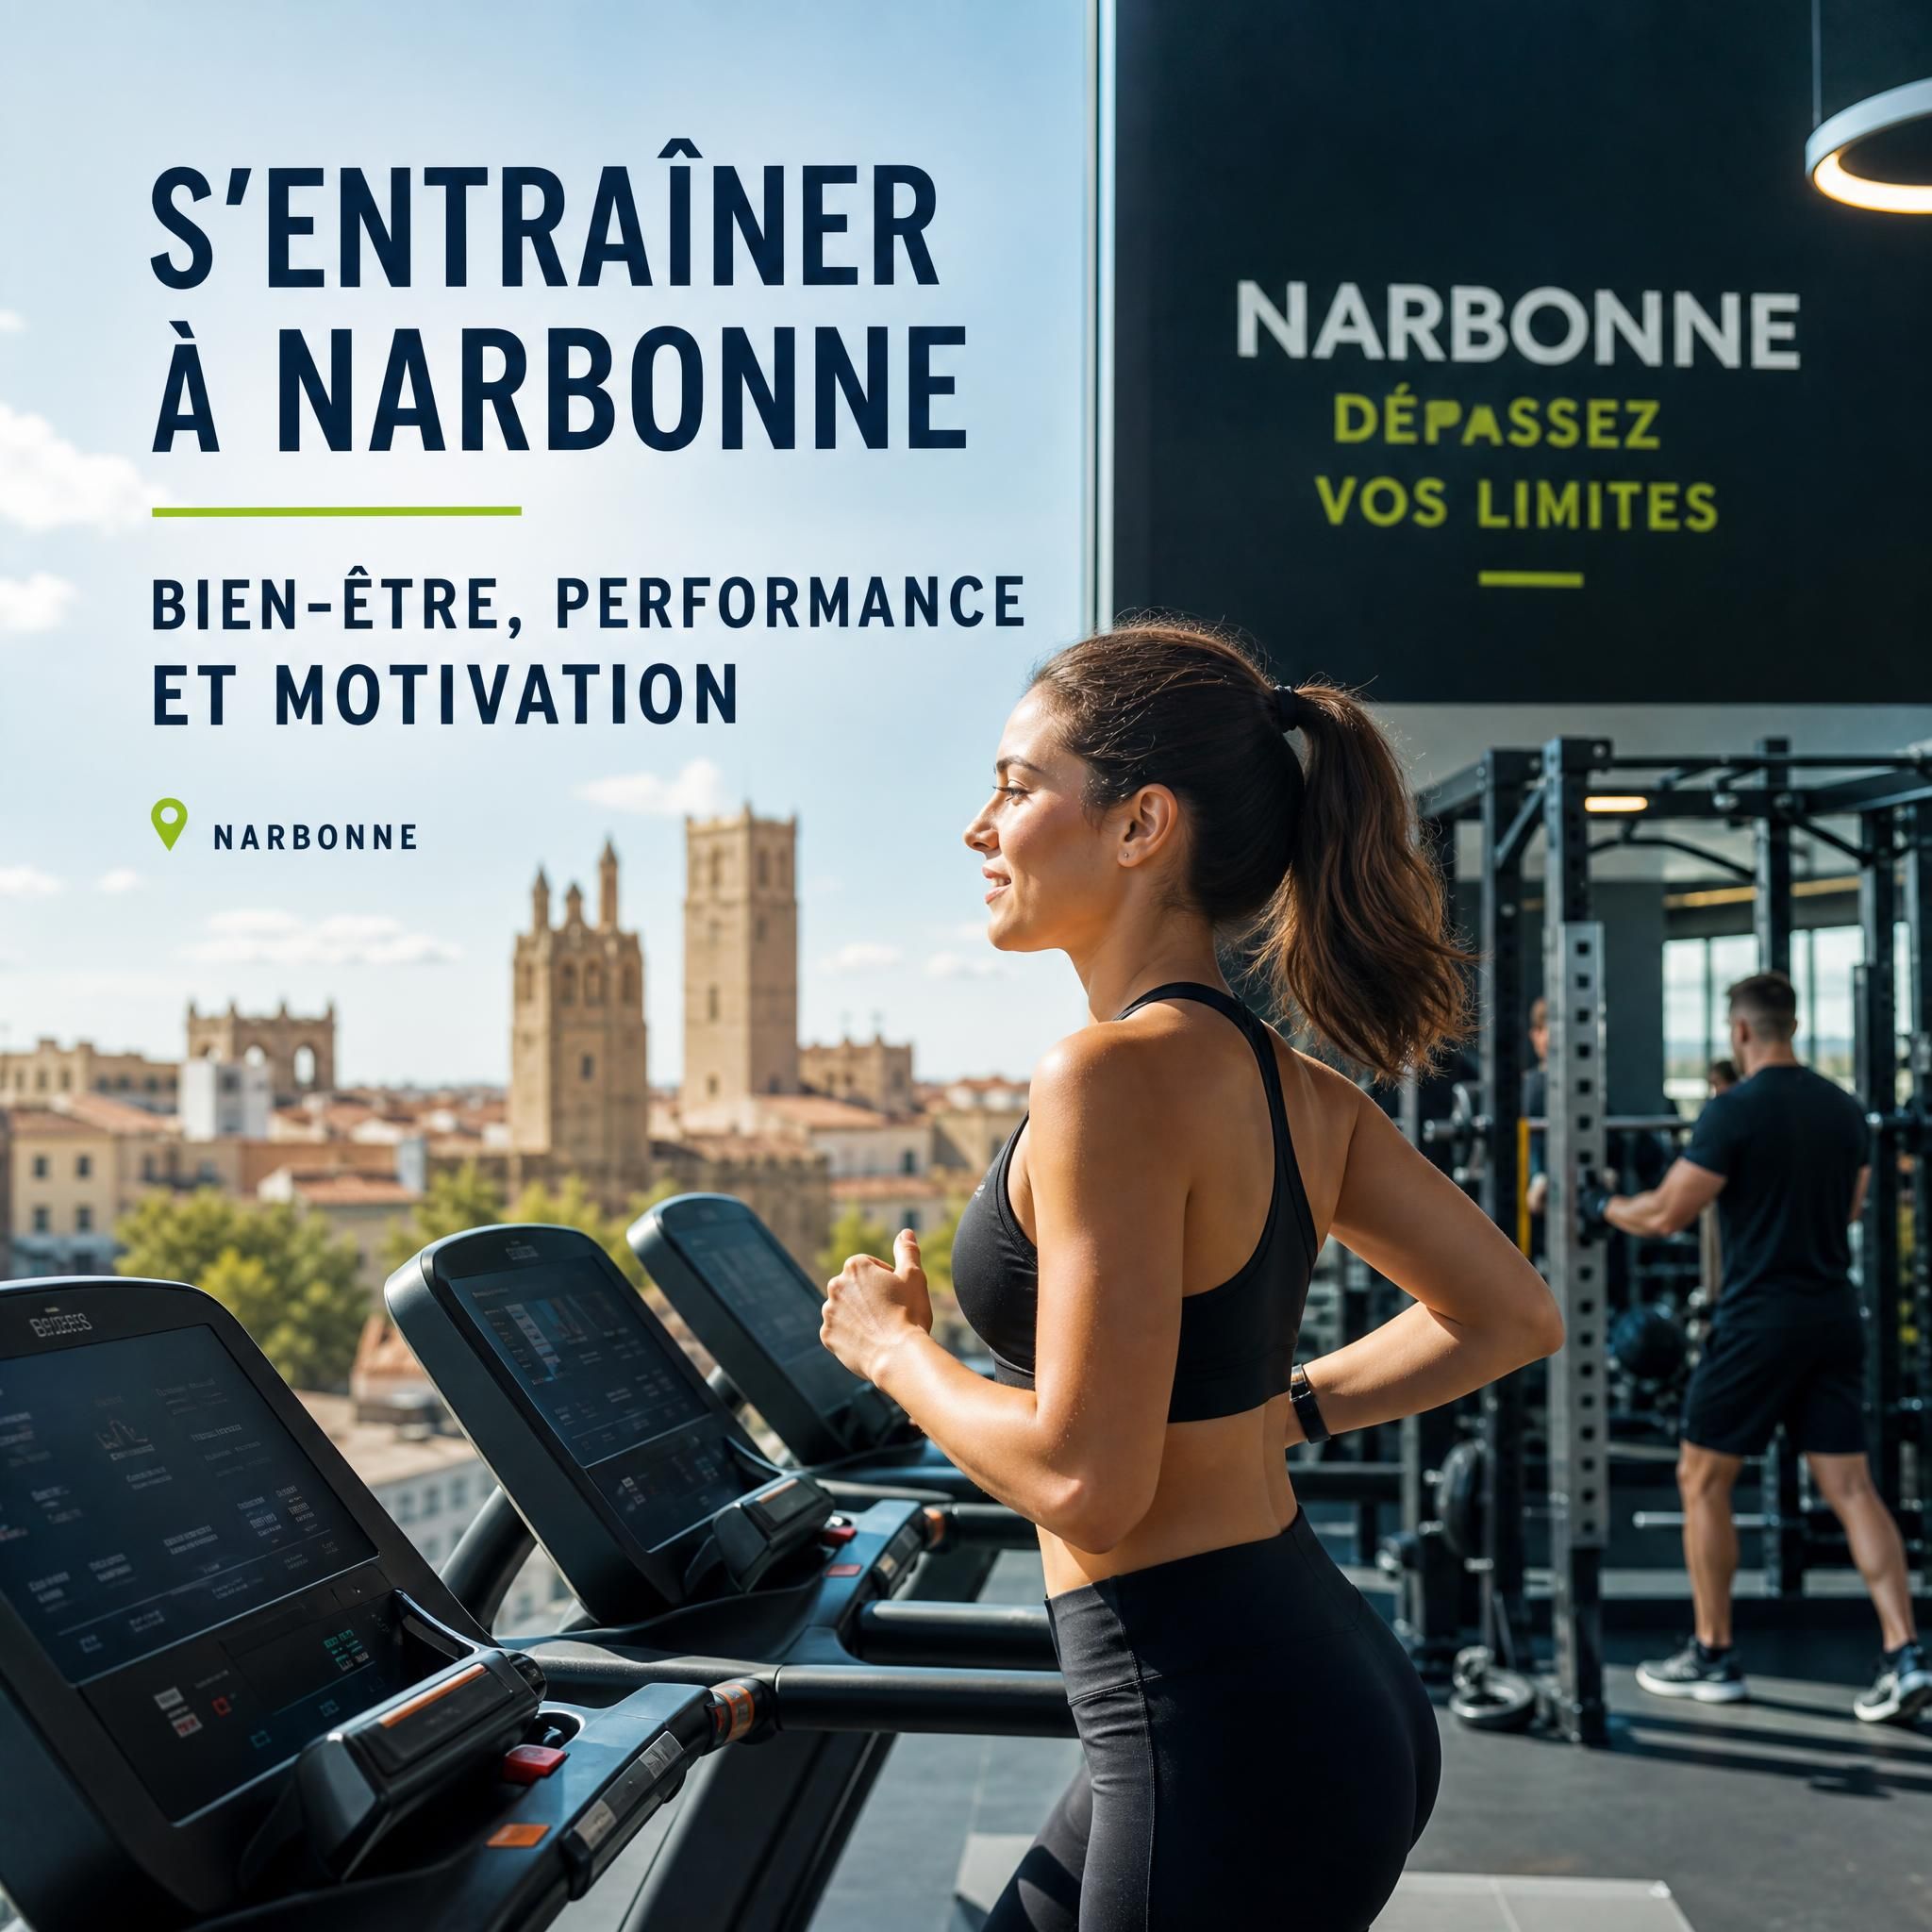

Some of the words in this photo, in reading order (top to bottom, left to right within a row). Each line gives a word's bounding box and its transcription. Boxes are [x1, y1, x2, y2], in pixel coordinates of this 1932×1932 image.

[1237, 279, 1802, 370] NARBONNE
[1333, 382, 1661, 449] DÉPASSEZ
[1315, 475, 1448, 527] VOS
[1477, 478, 1719, 532] LIMITES
